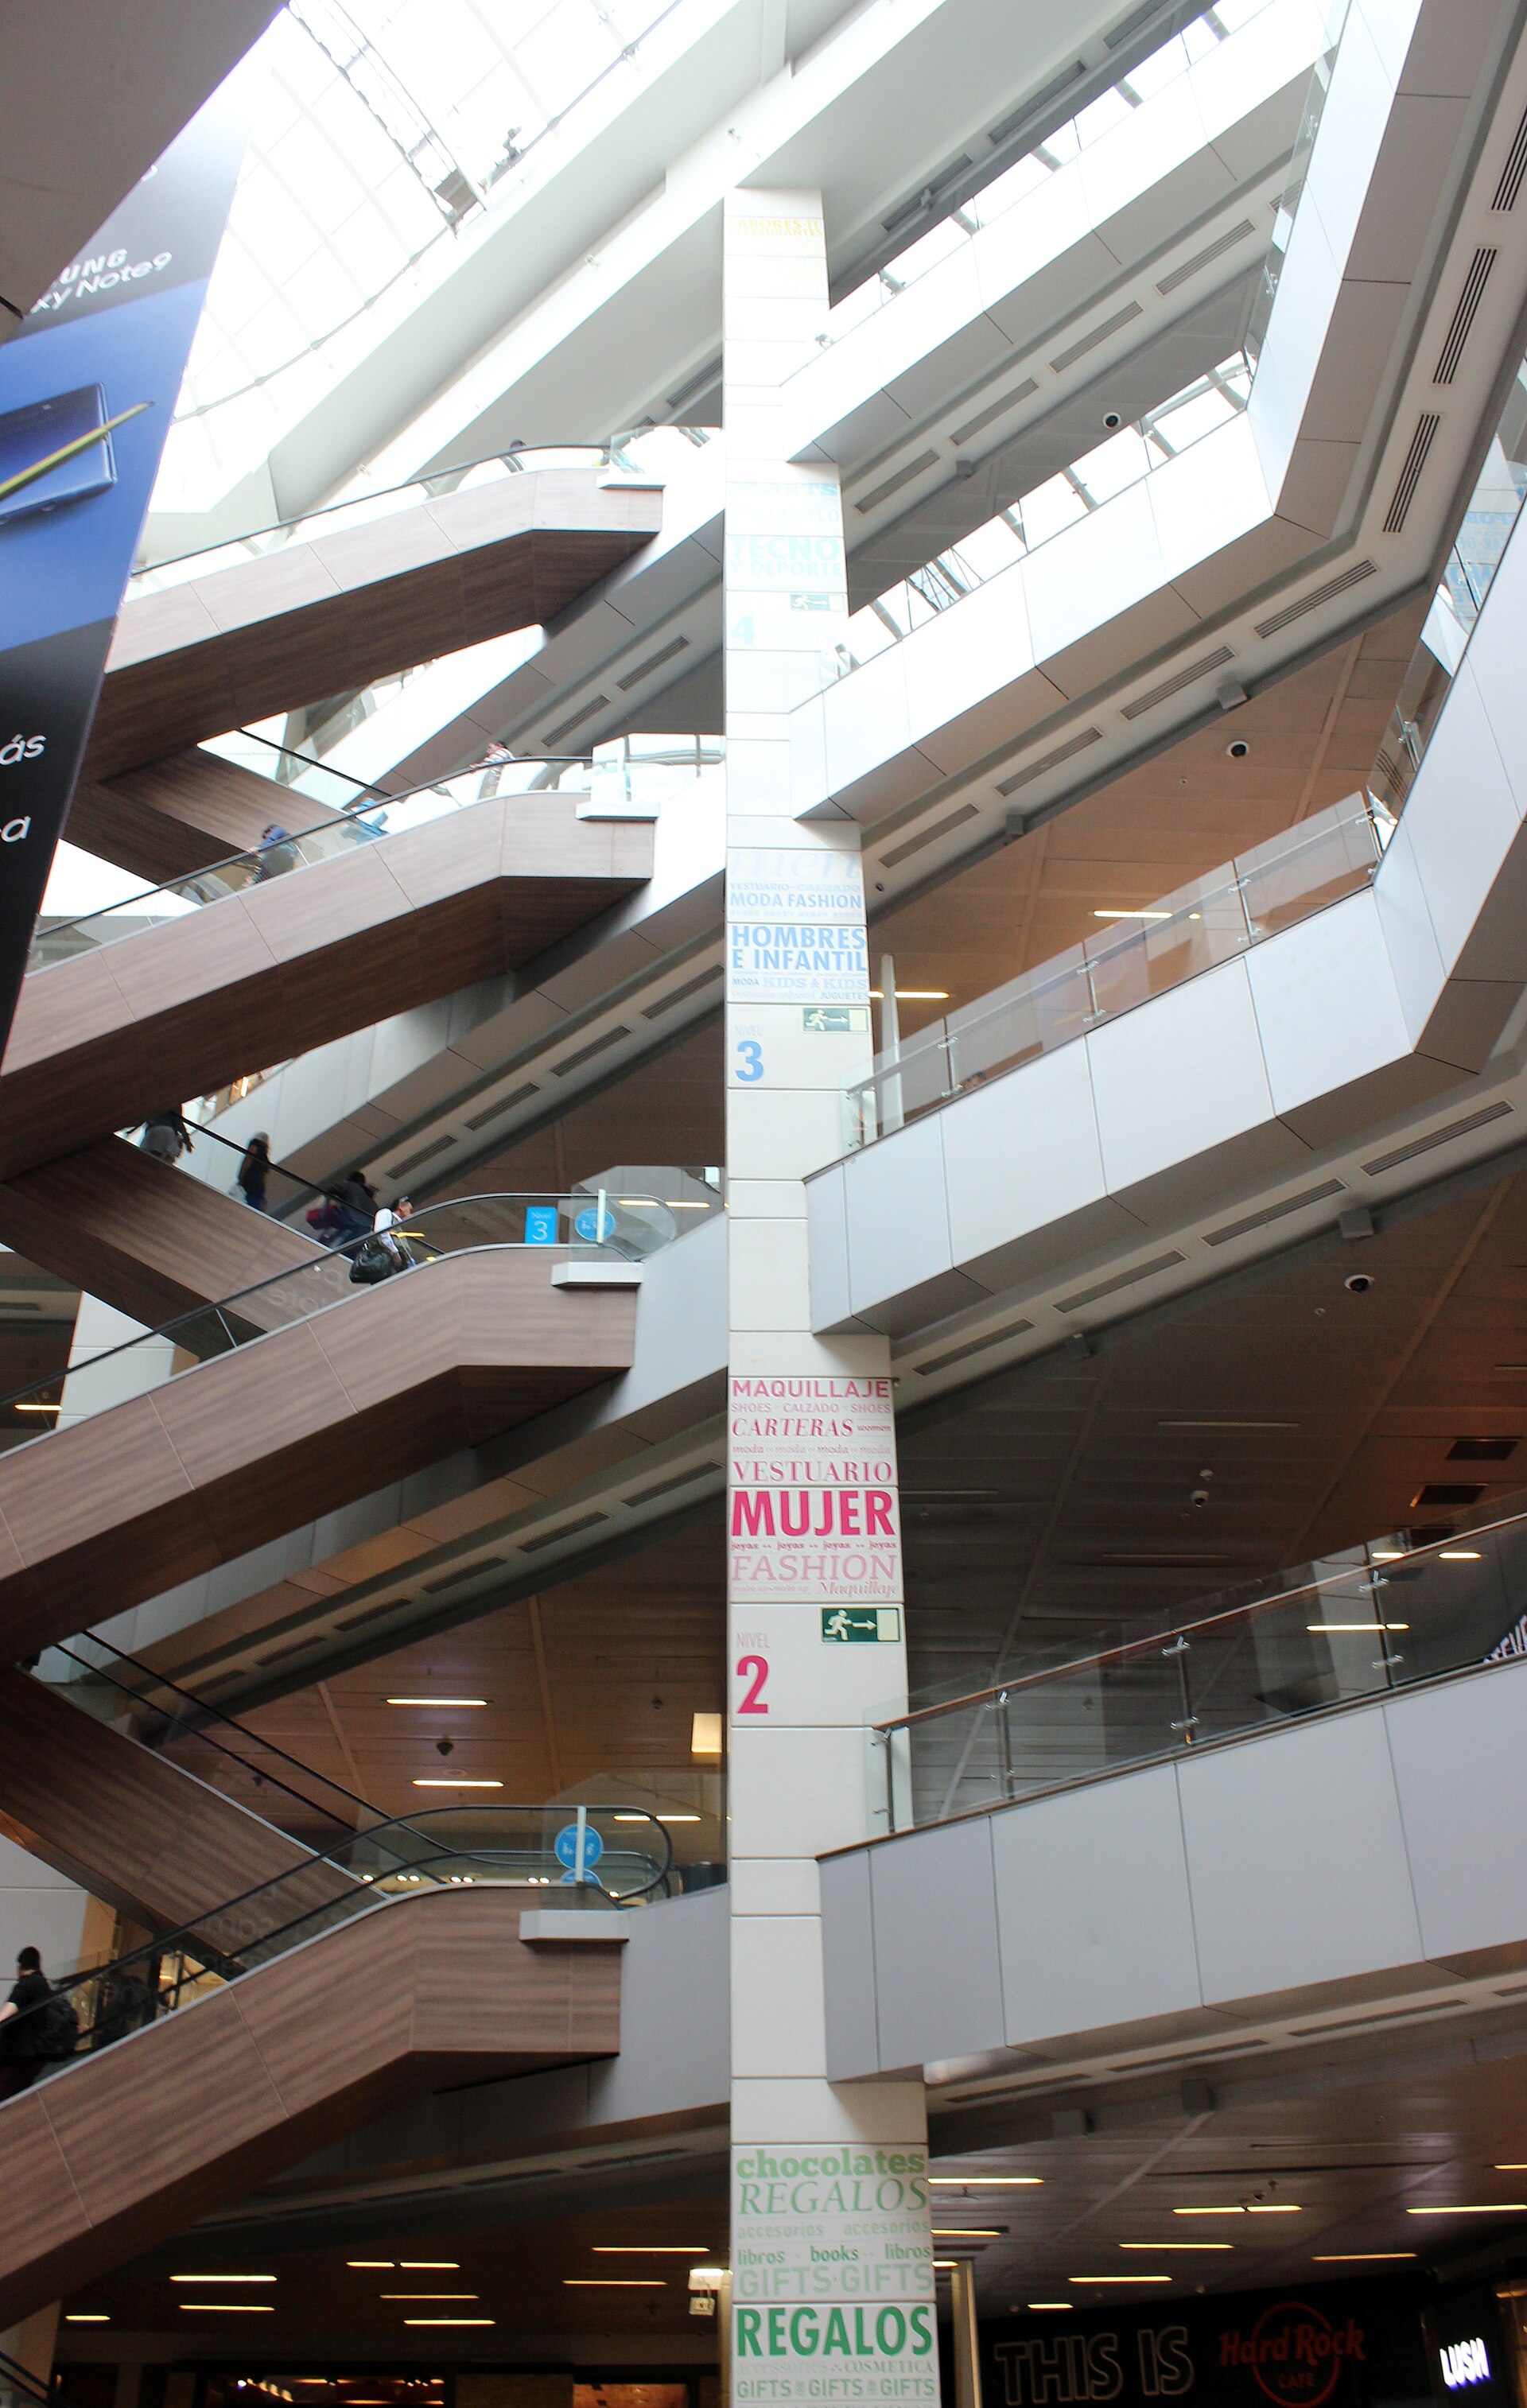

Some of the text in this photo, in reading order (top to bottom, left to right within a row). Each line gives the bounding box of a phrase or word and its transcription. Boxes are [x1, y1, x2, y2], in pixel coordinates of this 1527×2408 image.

[57, 249, 127, 286] UNG
[76, 251, 173, 298] Note9
[732, 537, 840, 560] TECNO
[731, 560, 843, 577] Y DEPORTE
[731, 614, 757, 645] 4
[730, 882, 790, 891] VESTUARIO
[730, 892, 862, 909] MODA FASHION
[732, 926, 866, 949] HOMBRES
[732, 949, 868, 971] E INFANTIL
[732, 977, 868, 990] MODA KIDS KIDS
[819, 992, 870, 1000] JUGUETES
[735, 1025, 763, 1037] NIVEL
[735, 1040, 764, 1082] 3
[532, 1221, 548, 1241] 3
[732, 1380, 891, 1399] MAQUILLAJE
[732, 1403, 892, 1414] SHOES CALZADO SHOES
[732, 1418, 853, 1437] CARTERAS
[732, 1443, 891, 1455] moda moda moda moda
[732, 1461, 892, 1482] VESTUARIO
[731, 1490, 896, 1536] MUJER
[730, 1540, 897, 1552] joyas joyas joyas joyas
[732, 1554, 897, 1581] FASHION
[736, 1632, 771, 1649] NIVEL
[736, 1655, 769, 1714] 2
[736, 2147, 926, 2178] chocolates
[738, 2177, 928, 2216] REGALOS
[737, 2218, 930, 2239] accesorios accesorios
[737, 2241, 932, 2266] libros books libros
[739, 2262, 933, 2297] GIFTS GIFTS
[736, 2305, 933, 2356] REGALOS
[1219, 2317, 1367, 2367] Hard Rock
[994, 2325, 1195, 2406] THIS IS
[1440, 2336, 1490, 2389] LUSH
[736, 2378, 935, 2398] GIFTS GIFTS GIFTS
[1278, 2373, 1316, 2390] CAFE
